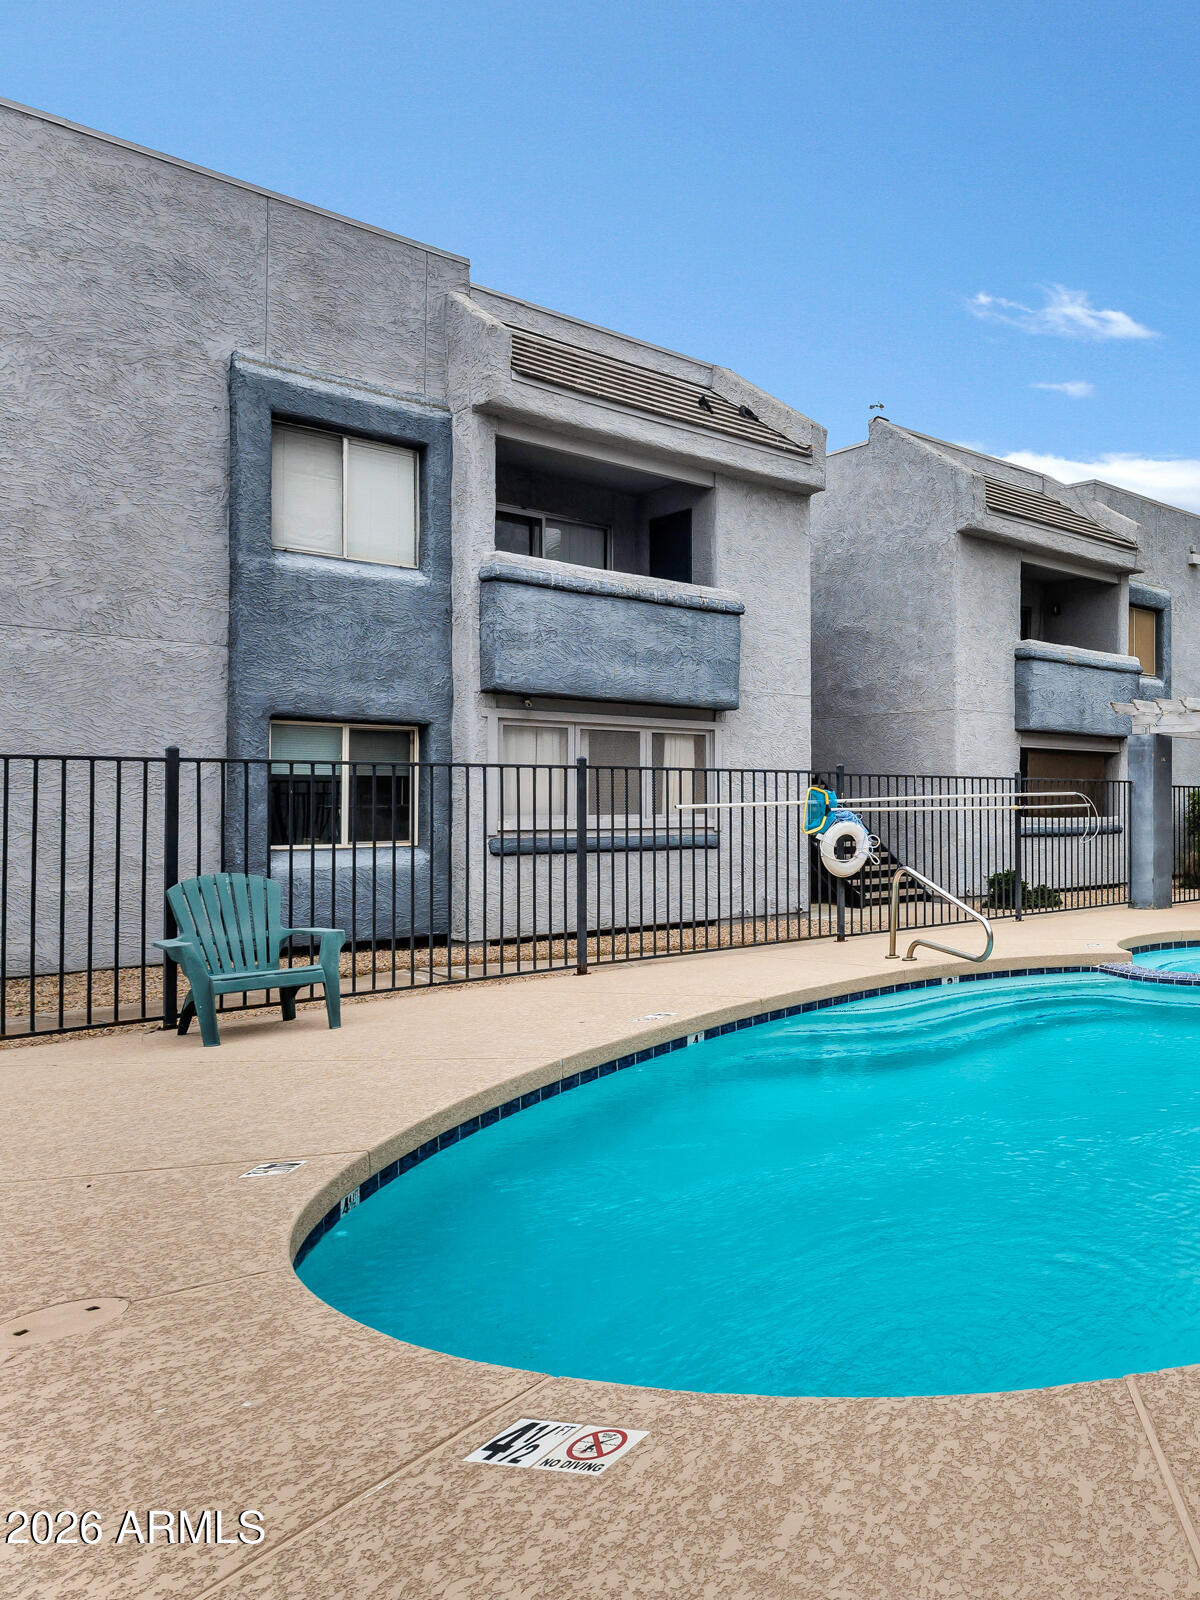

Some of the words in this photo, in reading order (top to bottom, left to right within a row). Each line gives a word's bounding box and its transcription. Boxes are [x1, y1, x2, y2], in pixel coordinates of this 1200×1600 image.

[554, 1425, 577, 1436] FT
[539, 1458, 562, 1468] NO
[559, 1460, 605, 1472] DIVING
